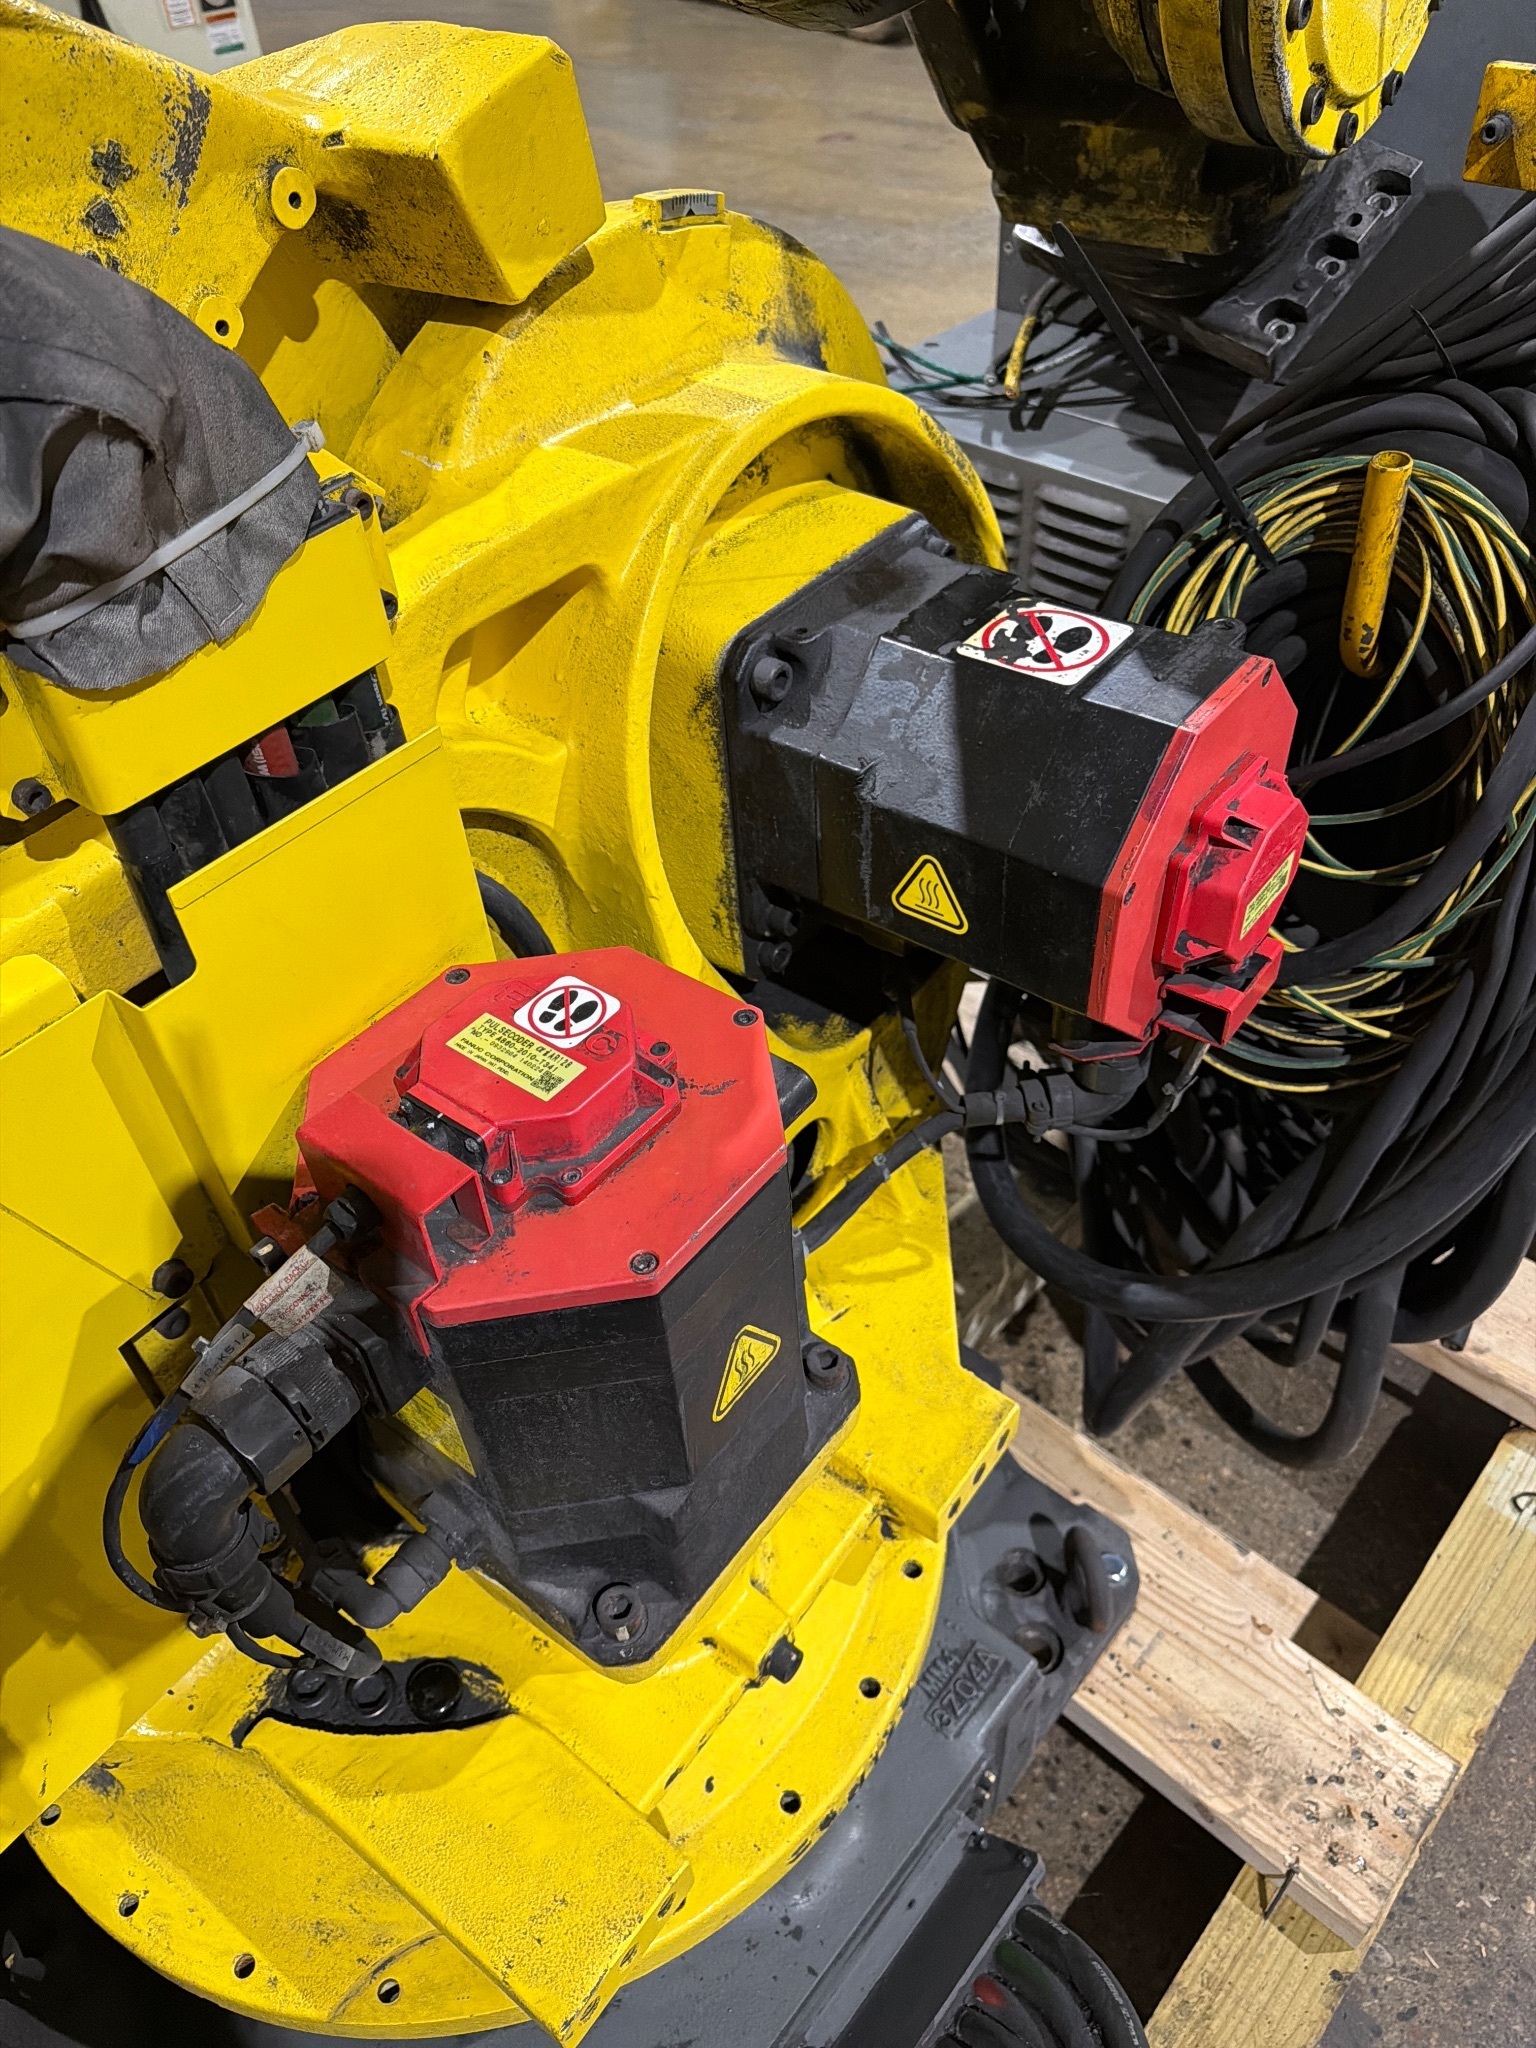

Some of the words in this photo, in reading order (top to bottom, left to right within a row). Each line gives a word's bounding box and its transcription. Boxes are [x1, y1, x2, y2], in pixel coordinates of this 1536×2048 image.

[476, 1024, 497, 1038] TYPE
[484, 1018, 534, 1050] PULSECODER
[460, 1037, 484, 1053] FANUC
[484, 1050, 534, 1082] CORPORATION
